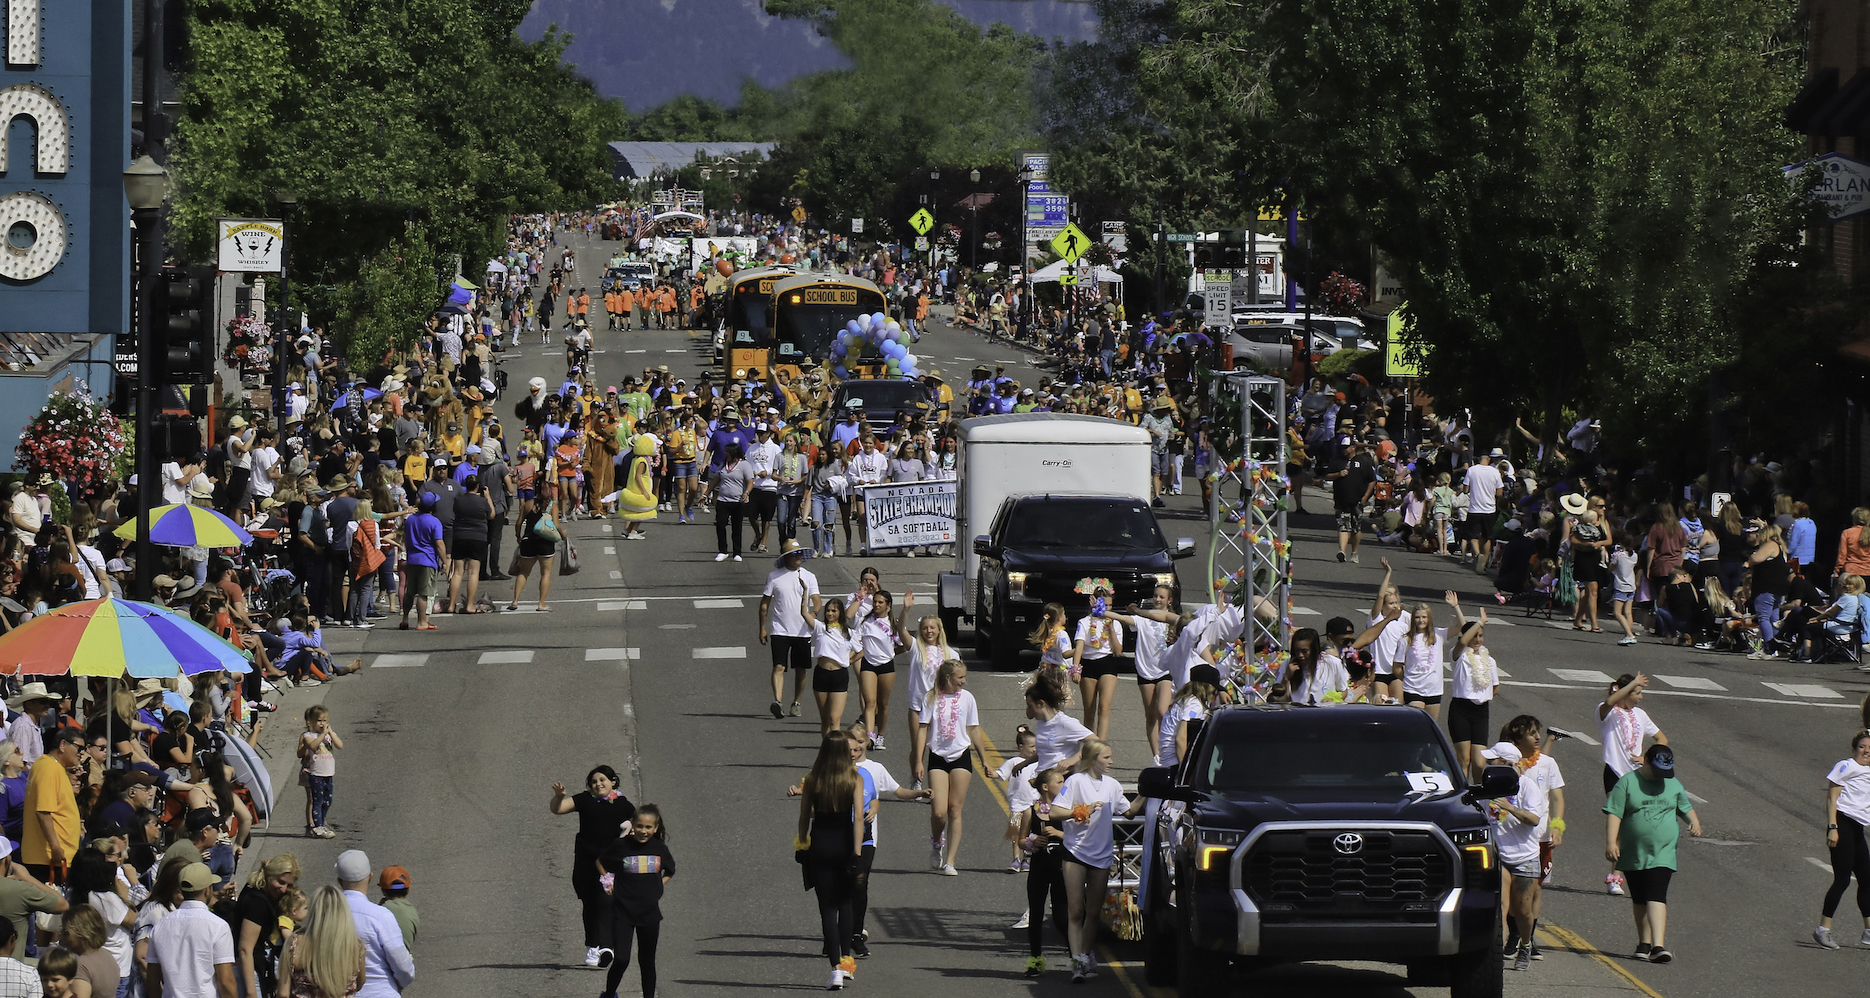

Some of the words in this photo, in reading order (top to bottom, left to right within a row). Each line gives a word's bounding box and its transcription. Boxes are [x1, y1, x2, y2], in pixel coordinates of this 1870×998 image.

[806, 291, 837, 302] SCHOOL
[840, 291, 856, 302] BUS
[1208, 299, 1226, 312] 15
[1042, 459, 1072, 467] Carry-On
[888, 486, 944, 497] NEVADA
[869, 496, 903, 530] STATE
[888, 525, 900, 535] 5A
[903, 521, 949, 534] SOFTBALL
[1422, 776, 1439, 790] 5
